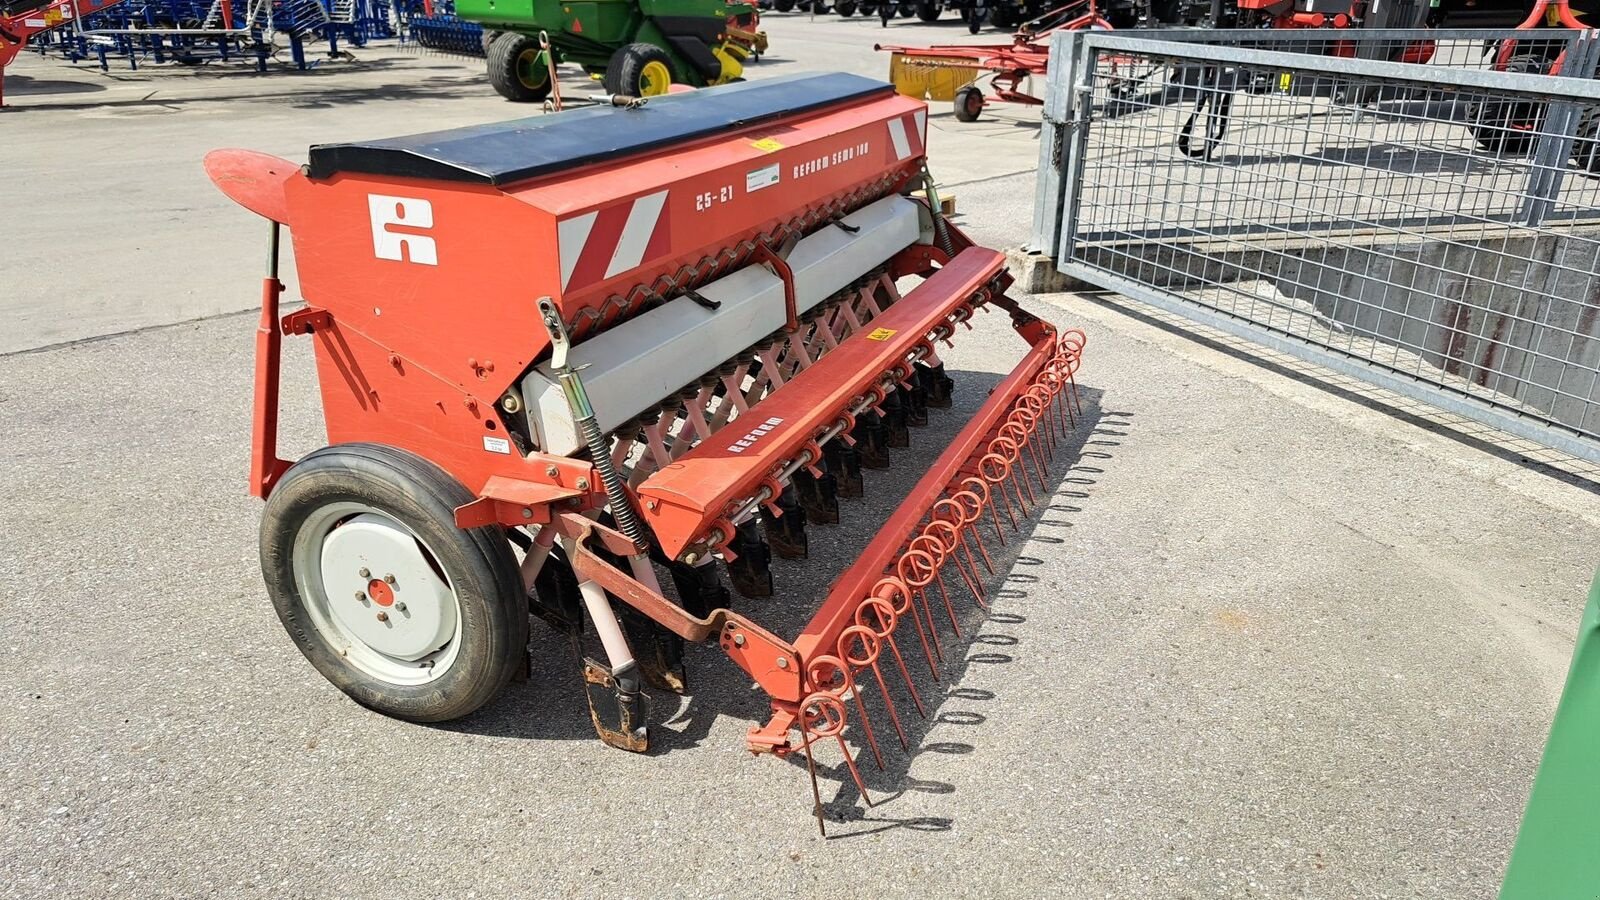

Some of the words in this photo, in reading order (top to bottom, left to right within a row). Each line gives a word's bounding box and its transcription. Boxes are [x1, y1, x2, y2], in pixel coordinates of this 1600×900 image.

[793, 156, 829, 179] REFORM
[832, 147, 854, 166] SEMO
[856, 142, 869, 157] 100
[727, 416, 784, 453] REFORM
